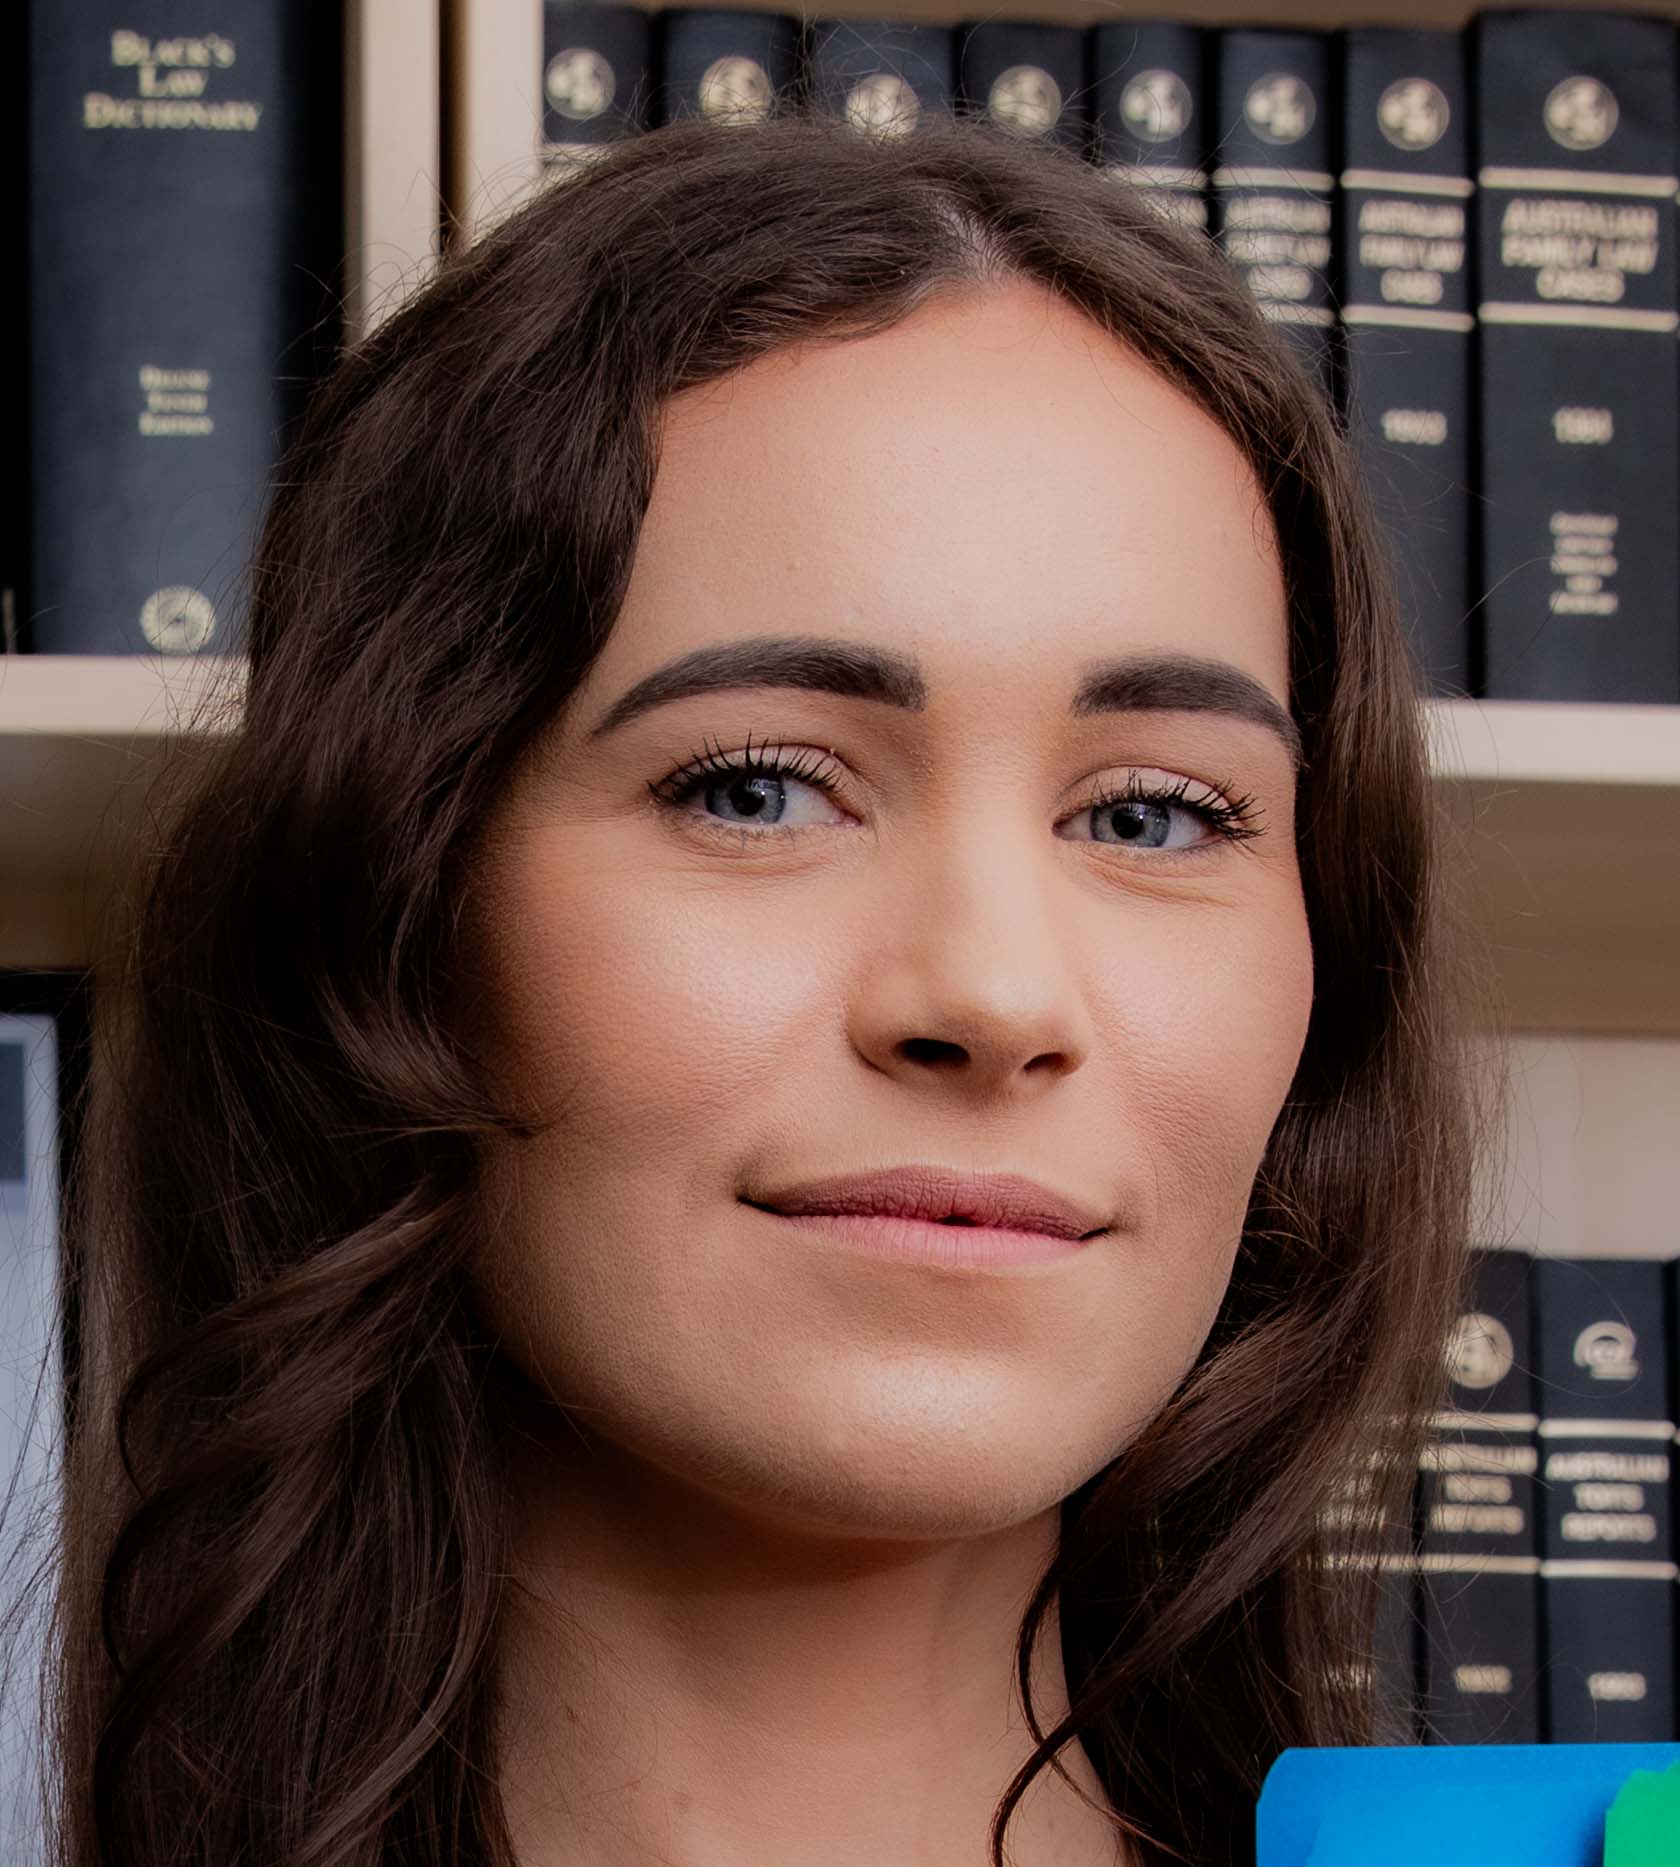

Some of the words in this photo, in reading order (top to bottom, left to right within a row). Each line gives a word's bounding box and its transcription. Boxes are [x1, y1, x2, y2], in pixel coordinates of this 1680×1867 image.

[1546, 1451, 1669, 1482] AUSTRALIAN
[1574, 1482, 1644, 1511] TORTS
[1562, 1513, 1656, 1542] REPORTS
